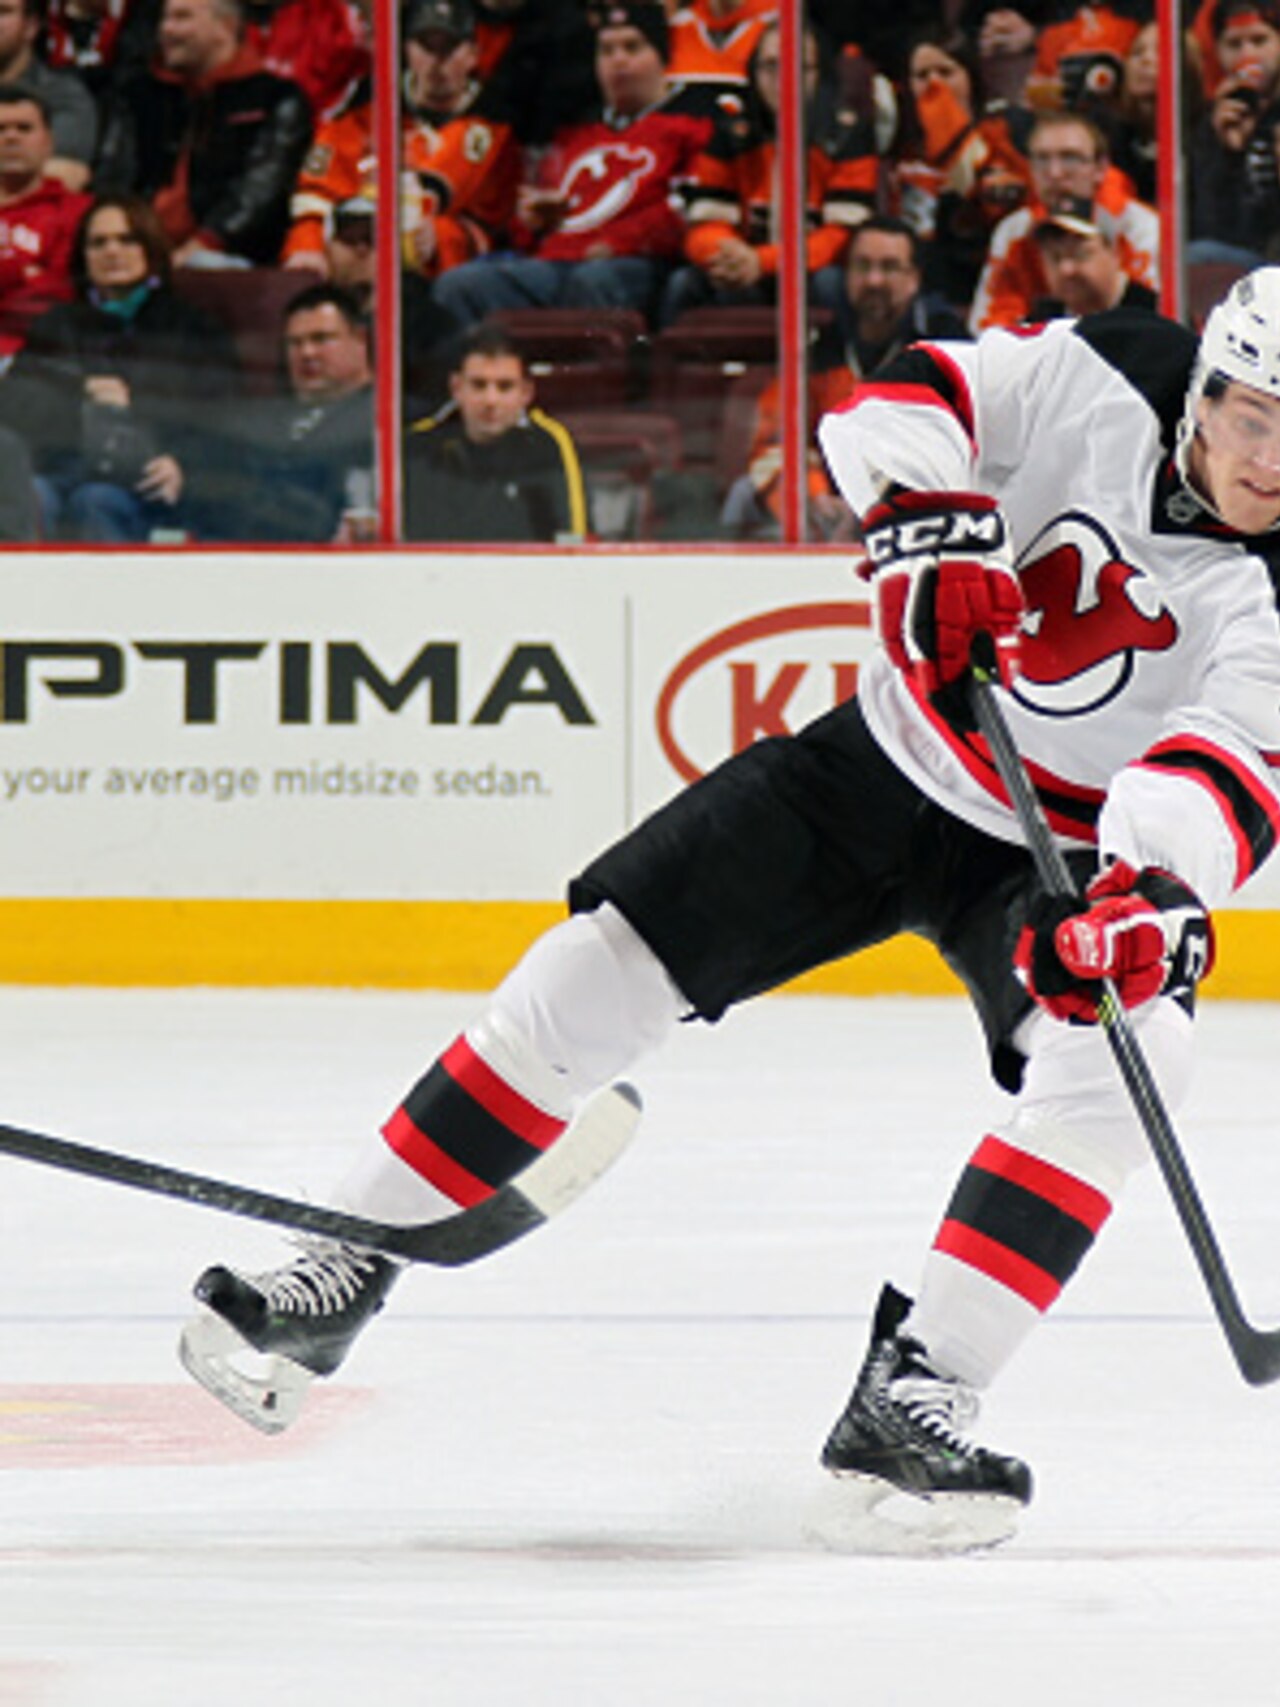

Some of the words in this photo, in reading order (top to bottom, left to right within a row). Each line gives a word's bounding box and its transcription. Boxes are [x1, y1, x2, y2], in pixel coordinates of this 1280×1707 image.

[865, 512, 997, 561] CCM
[0, 641, 597, 725] PTIMA
[2, 767, 90, 800] your
[104, 767, 260, 801] average
[274, 758, 420, 796] midsize
[433, 761, 552, 796] sedan.
